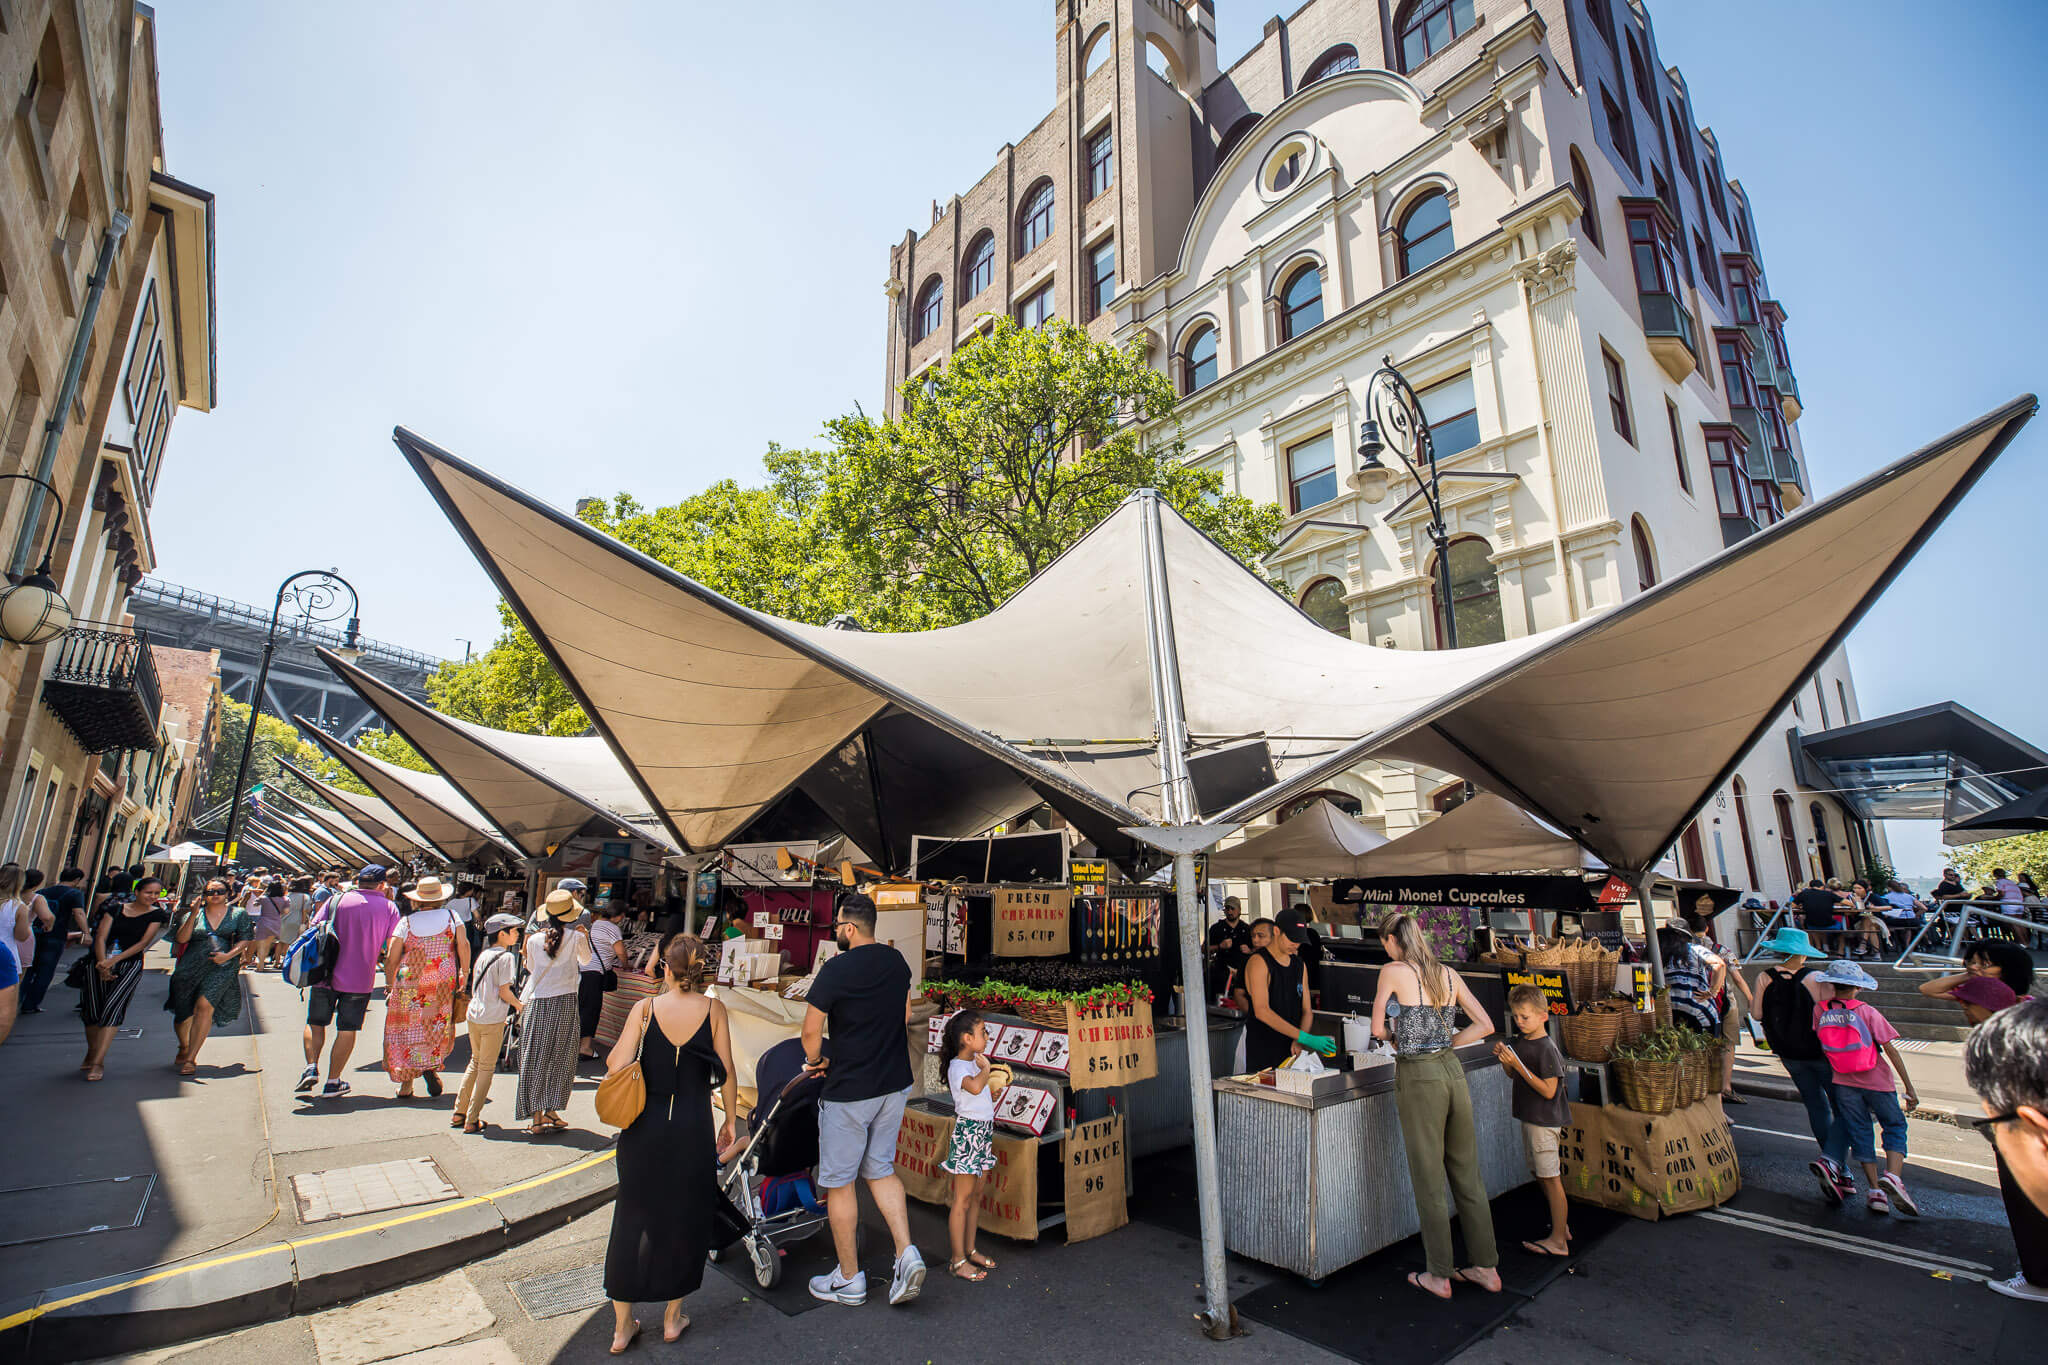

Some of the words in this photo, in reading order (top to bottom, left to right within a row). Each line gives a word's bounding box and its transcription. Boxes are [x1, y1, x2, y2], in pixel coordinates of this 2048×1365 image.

[1007, 893, 1050, 904] FRESH
[1363, 889, 1393, 902] Mini
[1399, 888, 1443, 902] Monet
[1448, 887, 1526, 906] Cupcakes
[927, 901, 944, 911] aula
[1001, 909, 1064, 920] CHERRIES
[1031, 929, 1055, 942] CUP
[1507, 972, 1535, 985] Meal
[1536, 974, 1563, 988] Deal
[1543, 989, 1563, 998] RINK
[1078, 1024, 1153, 1042] CHERRIES
[1118, 1053, 1139, 1070] CUP
[902, 1116, 935, 1138] RESH
[1082, 1121, 1112, 1140] YUM
[1559, 1126, 1585, 1143] ST
[1073, 1140, 1120, 1166] SINCE
[1559, 1143, 1585, 1162] RN
[1664, 1137, 1690, 1156] AUST
[1666, 1155, 1696, 1176] CORN
[1085, 1175, 1104, 1193] 96
[1677, 1178, 1693, 1193] CO
